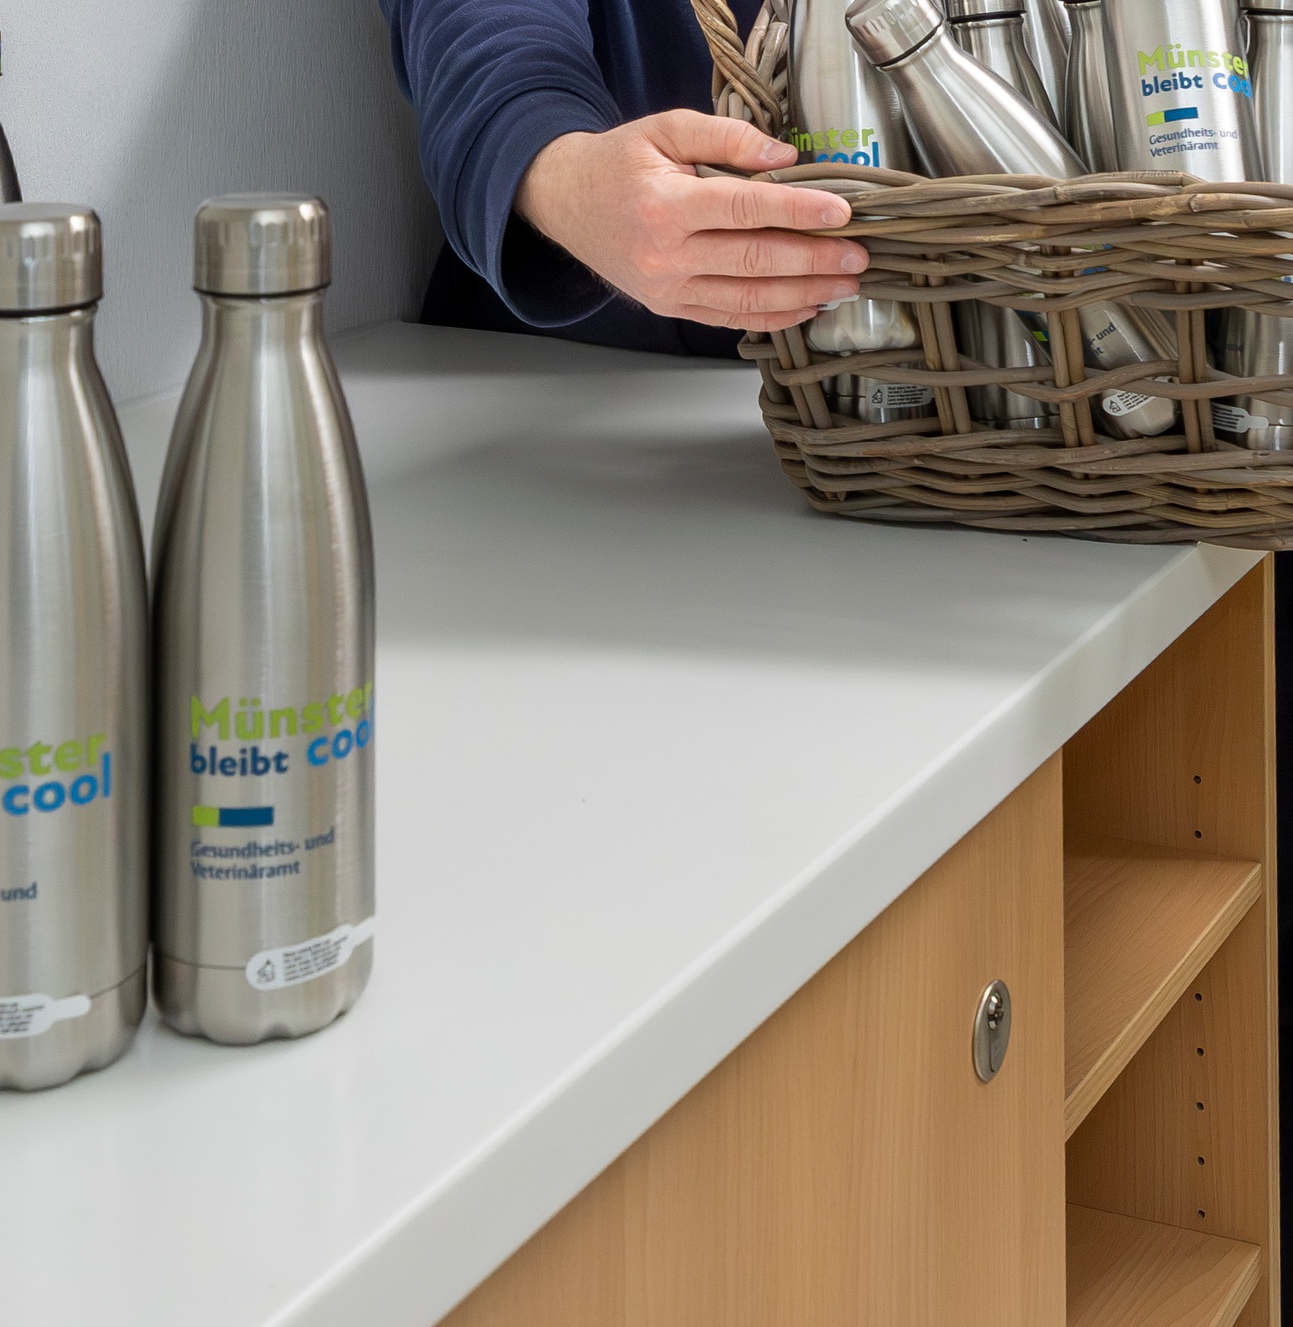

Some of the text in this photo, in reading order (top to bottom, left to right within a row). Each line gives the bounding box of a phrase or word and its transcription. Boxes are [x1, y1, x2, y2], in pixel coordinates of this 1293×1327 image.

[1141, 72, 1203, 97] bleibt
[1149, 127, 1238, 145] Gesundheits- und
[1149, 141, 1219, 158] Veterinäramt
[190, 742, 290, 777] bleibt
[3, 751, 111, 816] cool
[191, 825, 336, 860] Gesundheits- und
[190, 859, 301, 880] Veterinäramt
[0, 881, 37, 902] und
